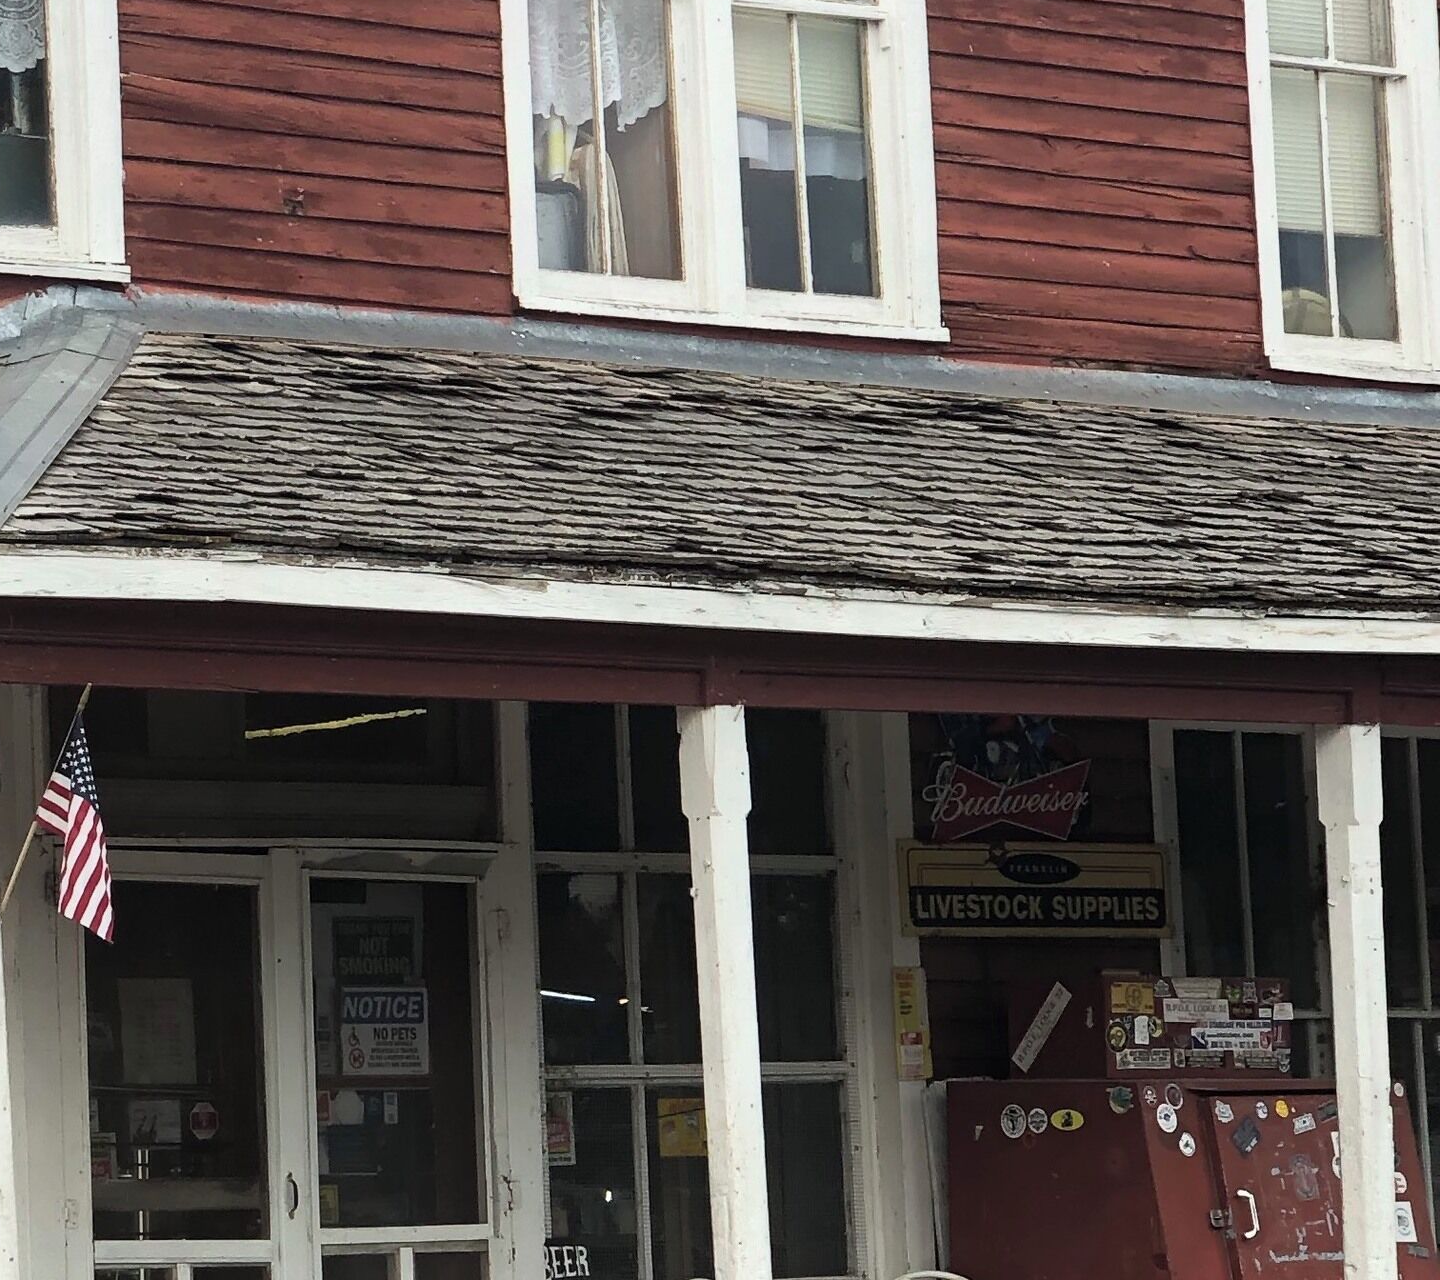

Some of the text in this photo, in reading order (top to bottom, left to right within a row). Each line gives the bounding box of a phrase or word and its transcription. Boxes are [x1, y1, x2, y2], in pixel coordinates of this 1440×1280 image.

[922, 770, 1089, 823] Budweiser
[916, 893, 1159, 921] LIVESTOCK SUPPLIES
[343, 995, 422, 1020] NOTICE
[373, 1026, 417, 1040] NO PETS
